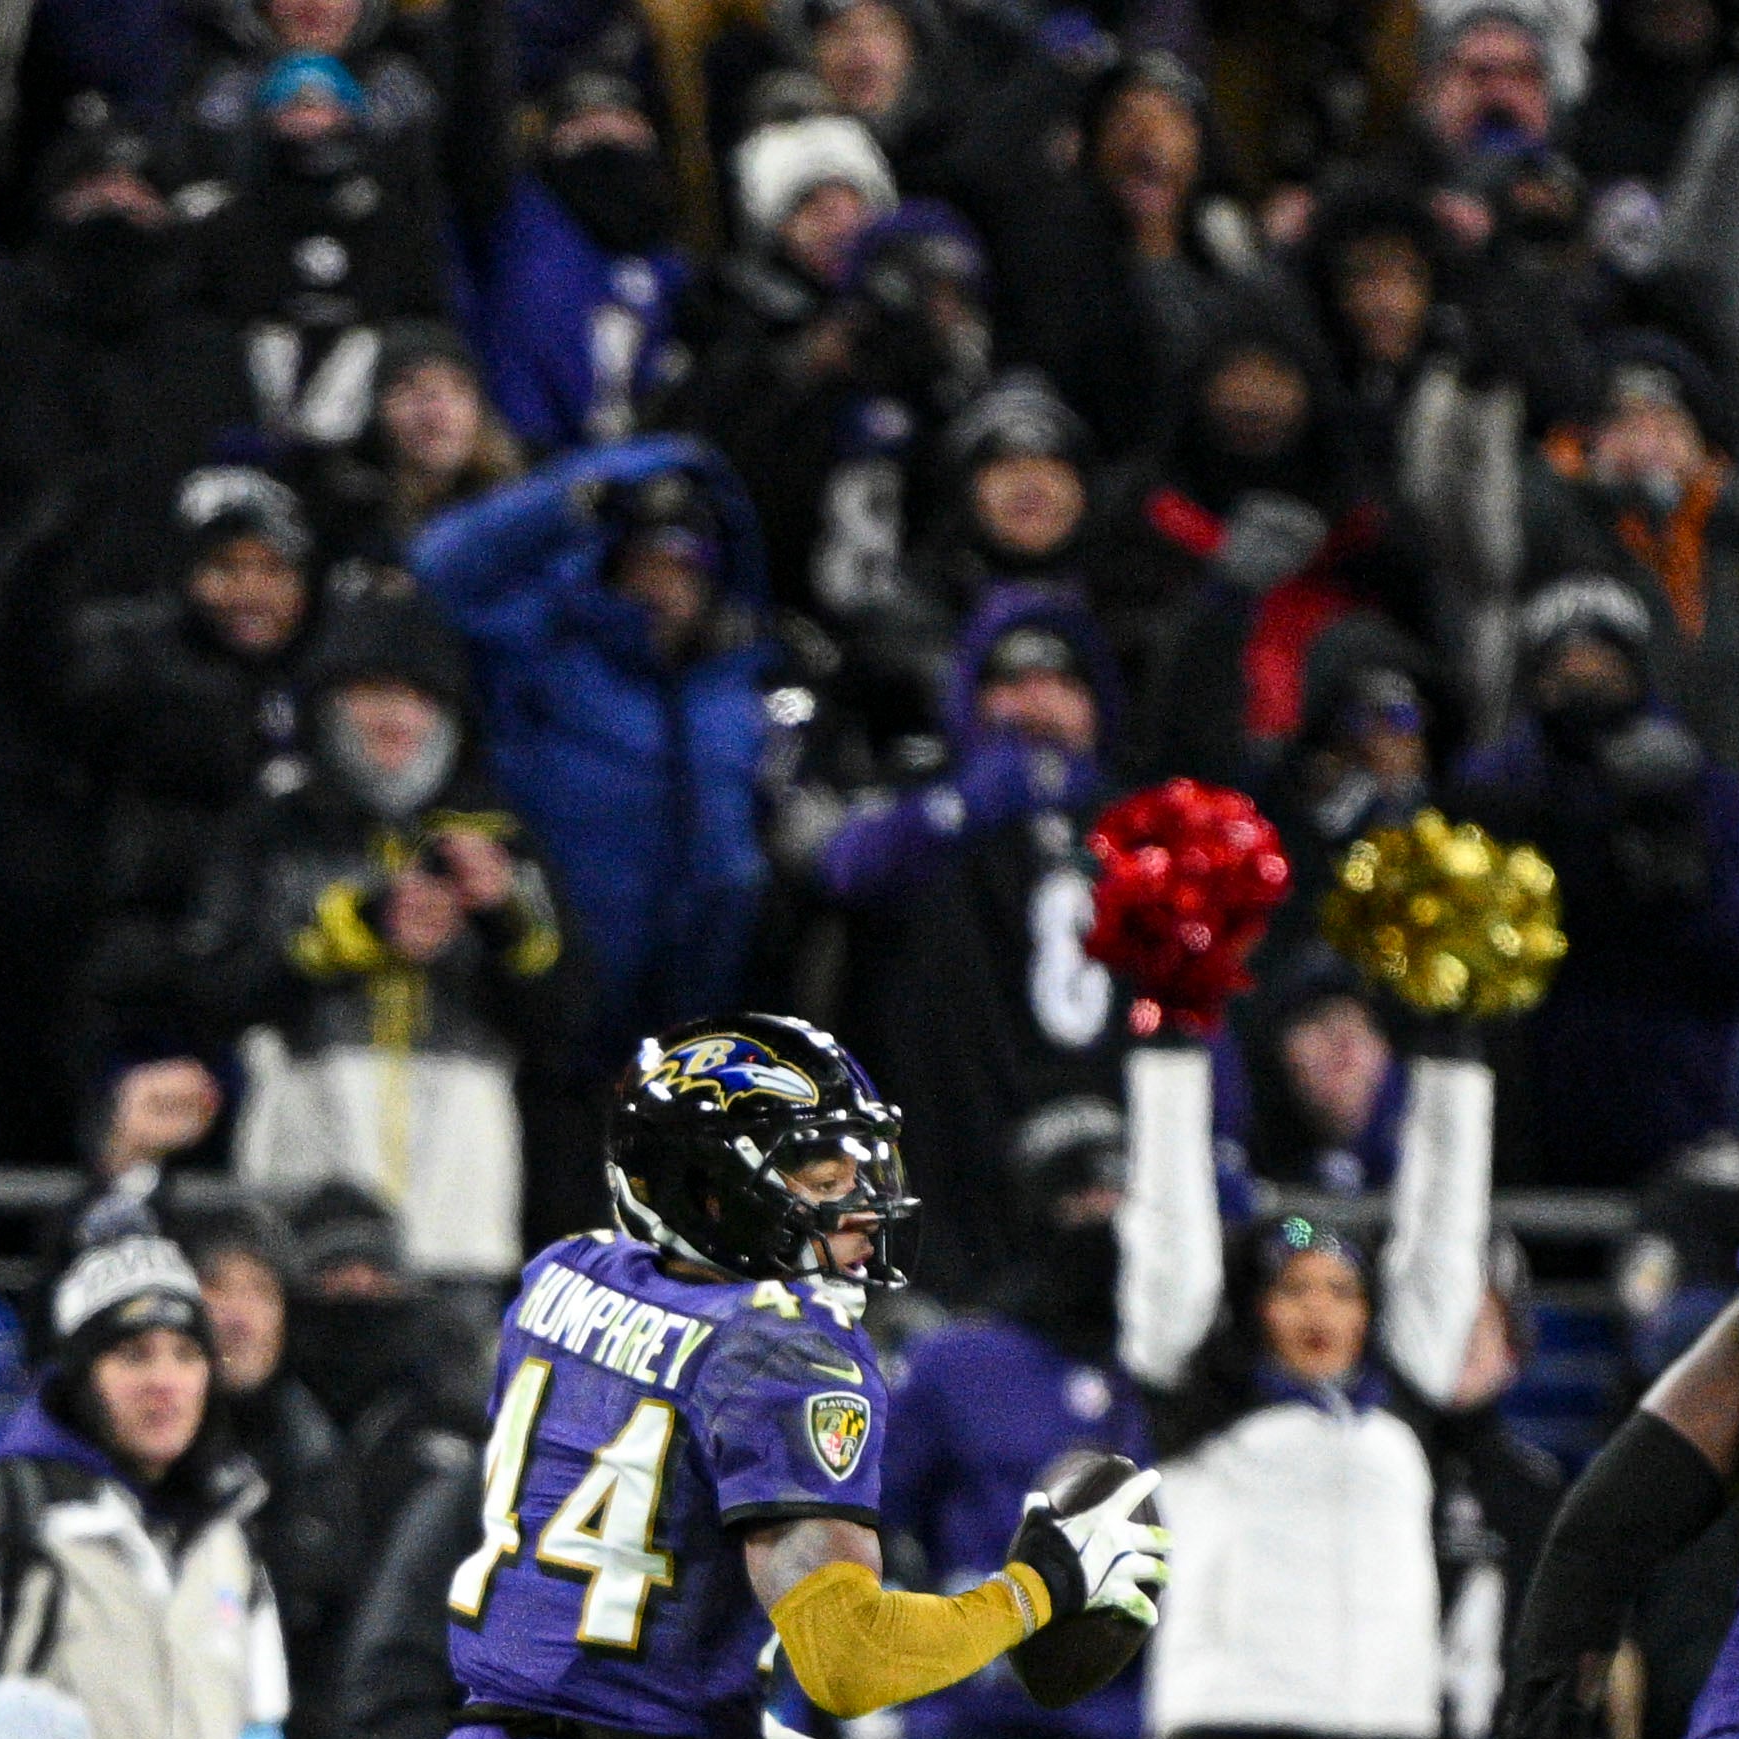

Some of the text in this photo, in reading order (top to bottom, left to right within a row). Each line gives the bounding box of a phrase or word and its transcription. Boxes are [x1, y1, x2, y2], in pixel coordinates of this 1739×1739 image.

[516, 1261, 713, 1390] HUMPHREY
[816, 1399, 864, 1412] RAVENS
[448, 1357, 676, 1650] 44
